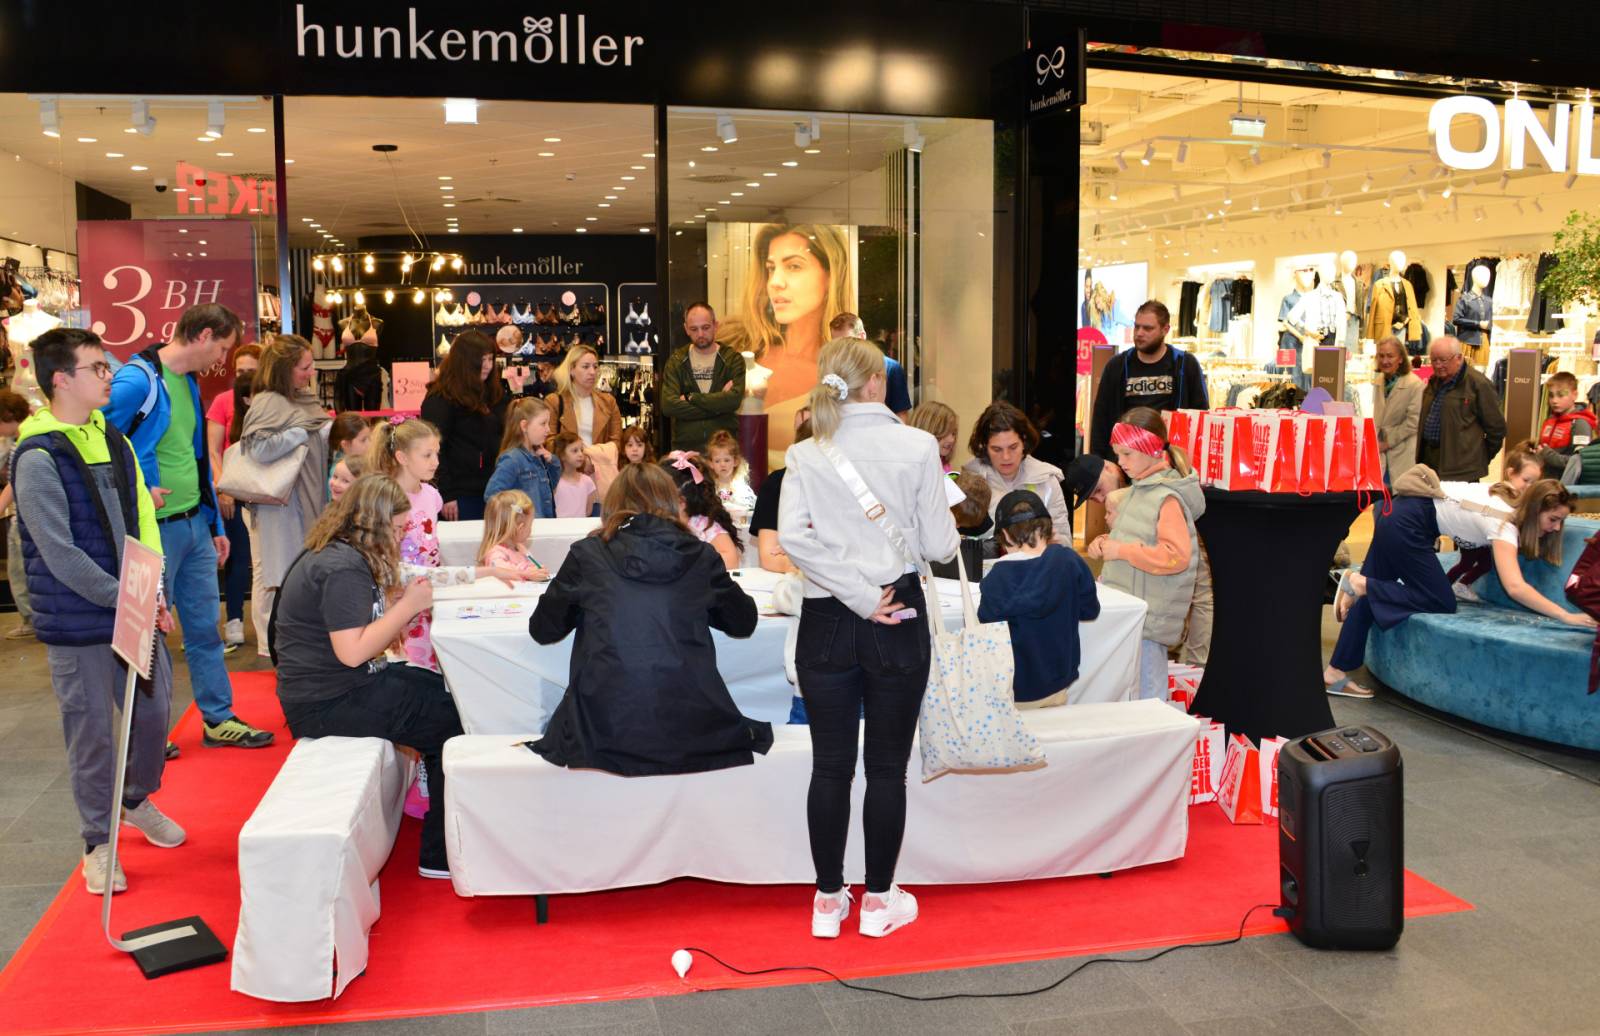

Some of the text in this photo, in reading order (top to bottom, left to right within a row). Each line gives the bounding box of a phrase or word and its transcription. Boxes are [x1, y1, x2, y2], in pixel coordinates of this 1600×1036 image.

[297, 4, 644, 66] hunkemöller
[160, 279, 224, 310] BH
[1126, 380, 1175, 392] adidas
